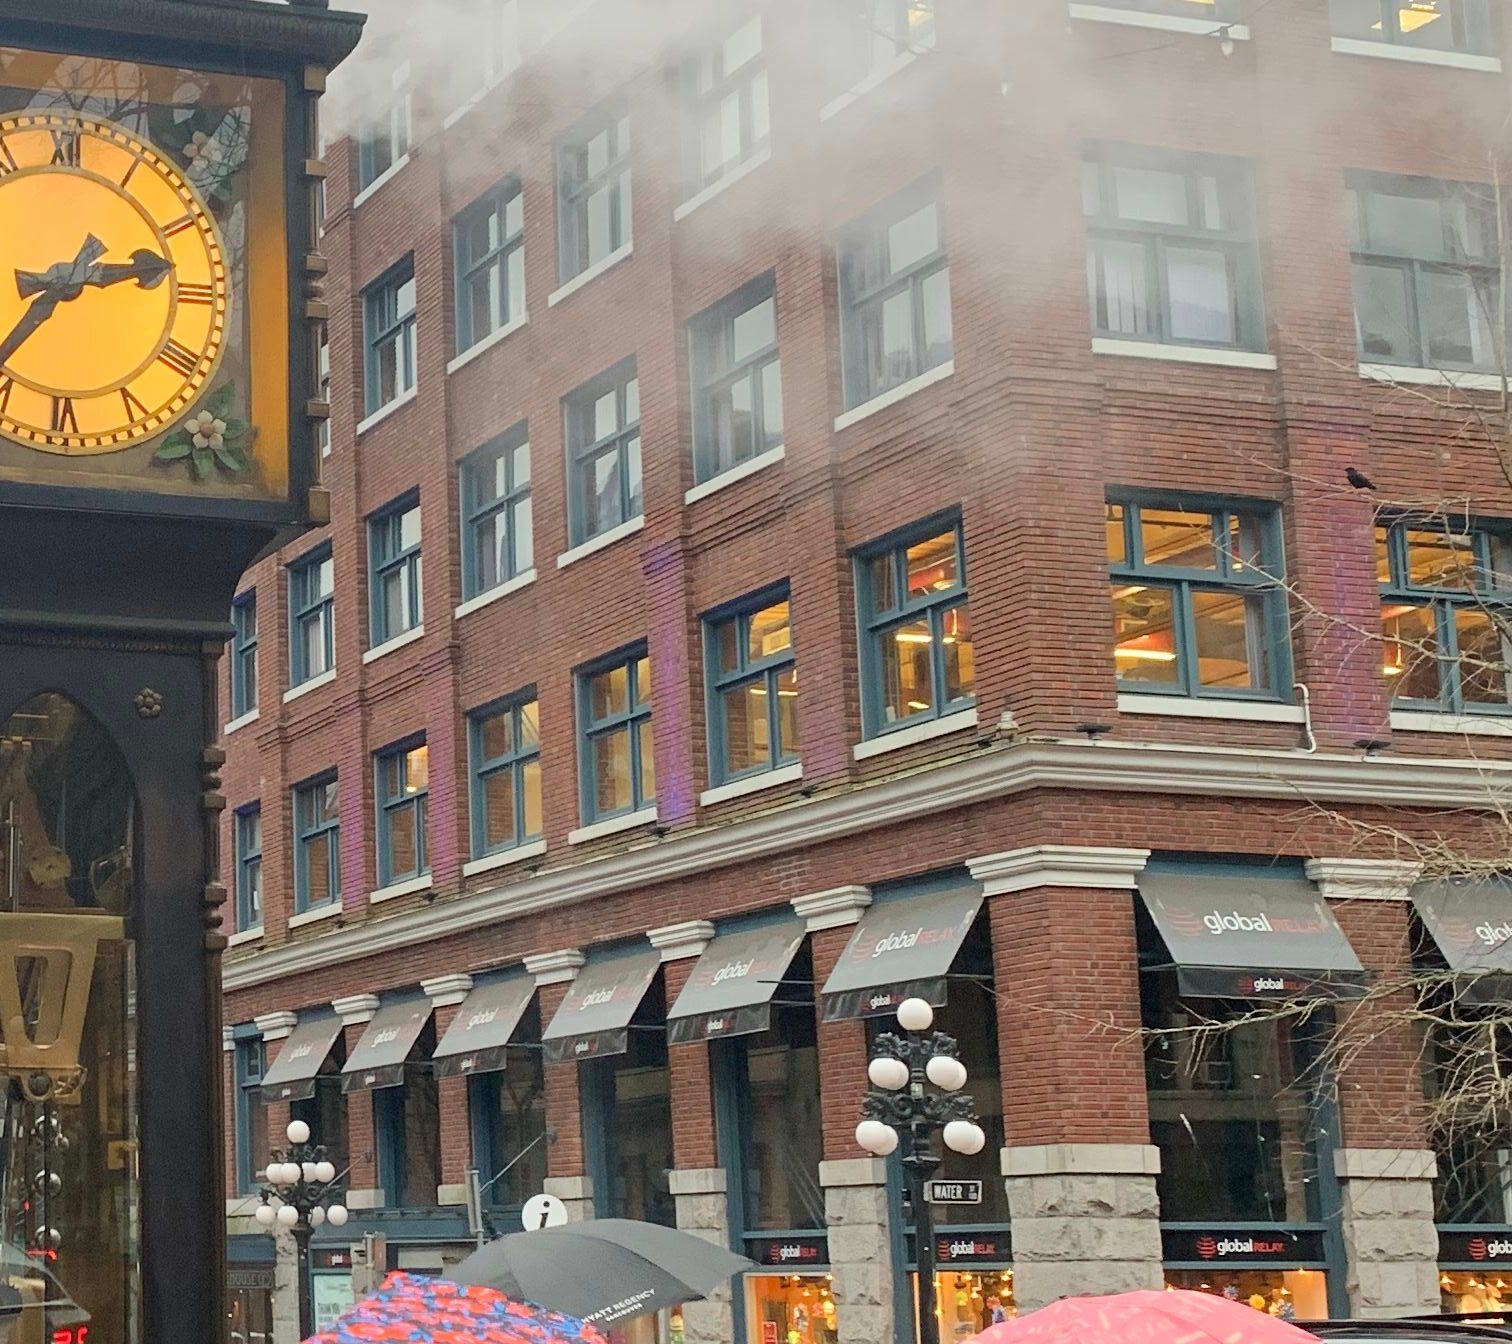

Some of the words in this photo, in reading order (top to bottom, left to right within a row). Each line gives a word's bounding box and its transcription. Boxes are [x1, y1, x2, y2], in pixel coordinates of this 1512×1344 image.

[933, 1184, 963, 1200] WATER
[581, 1306, 613, 1324] HYATT
[613, 1288, 656, 1311] REGENCY
